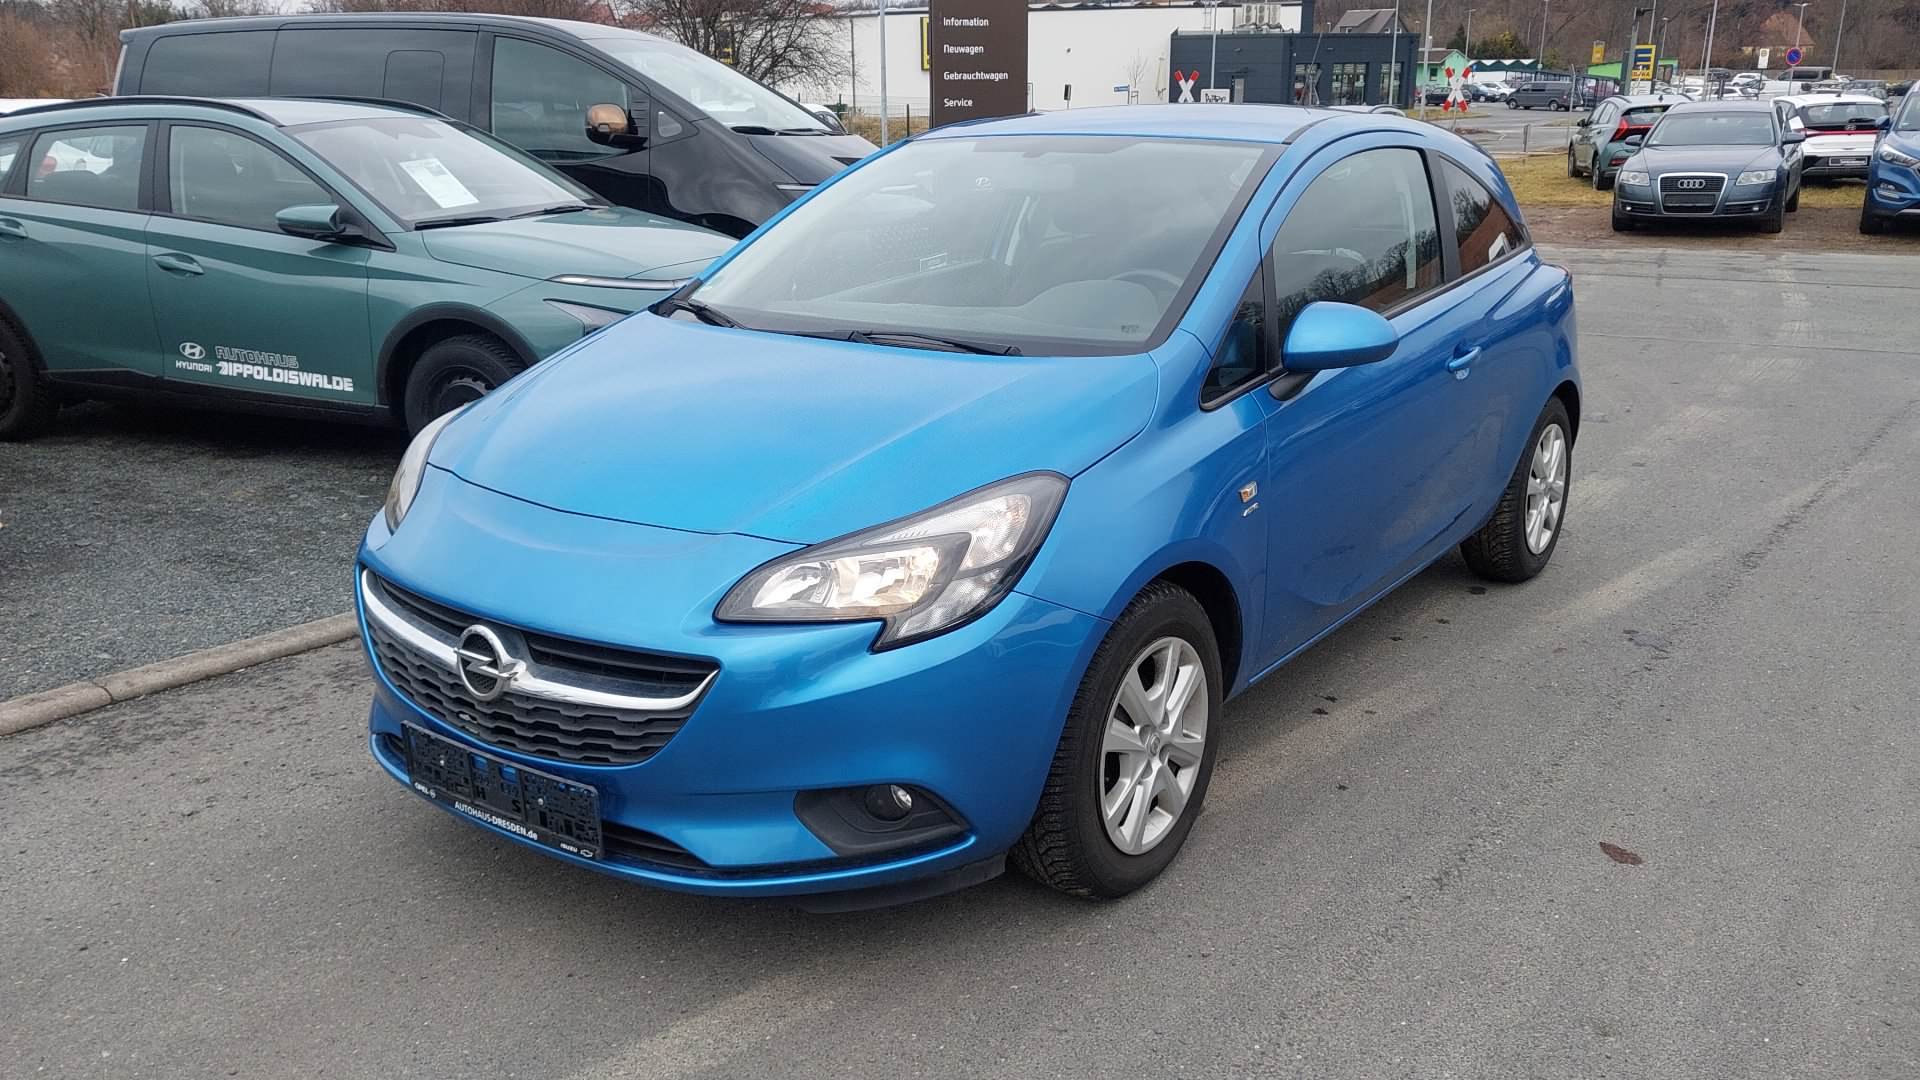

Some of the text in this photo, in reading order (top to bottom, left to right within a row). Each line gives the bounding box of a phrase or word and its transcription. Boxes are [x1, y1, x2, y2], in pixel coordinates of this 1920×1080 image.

[943, 16, 989, 27] Information
[943, 44, 985, 55] Neuwagen
[943, 71, 1009, 82] Gebrauchtwagen
[943, 98, 973, 107] Service
[214, 346, 300, 369] AUTOHAUS
[175, 359, 213, 373] HYUNDAI
